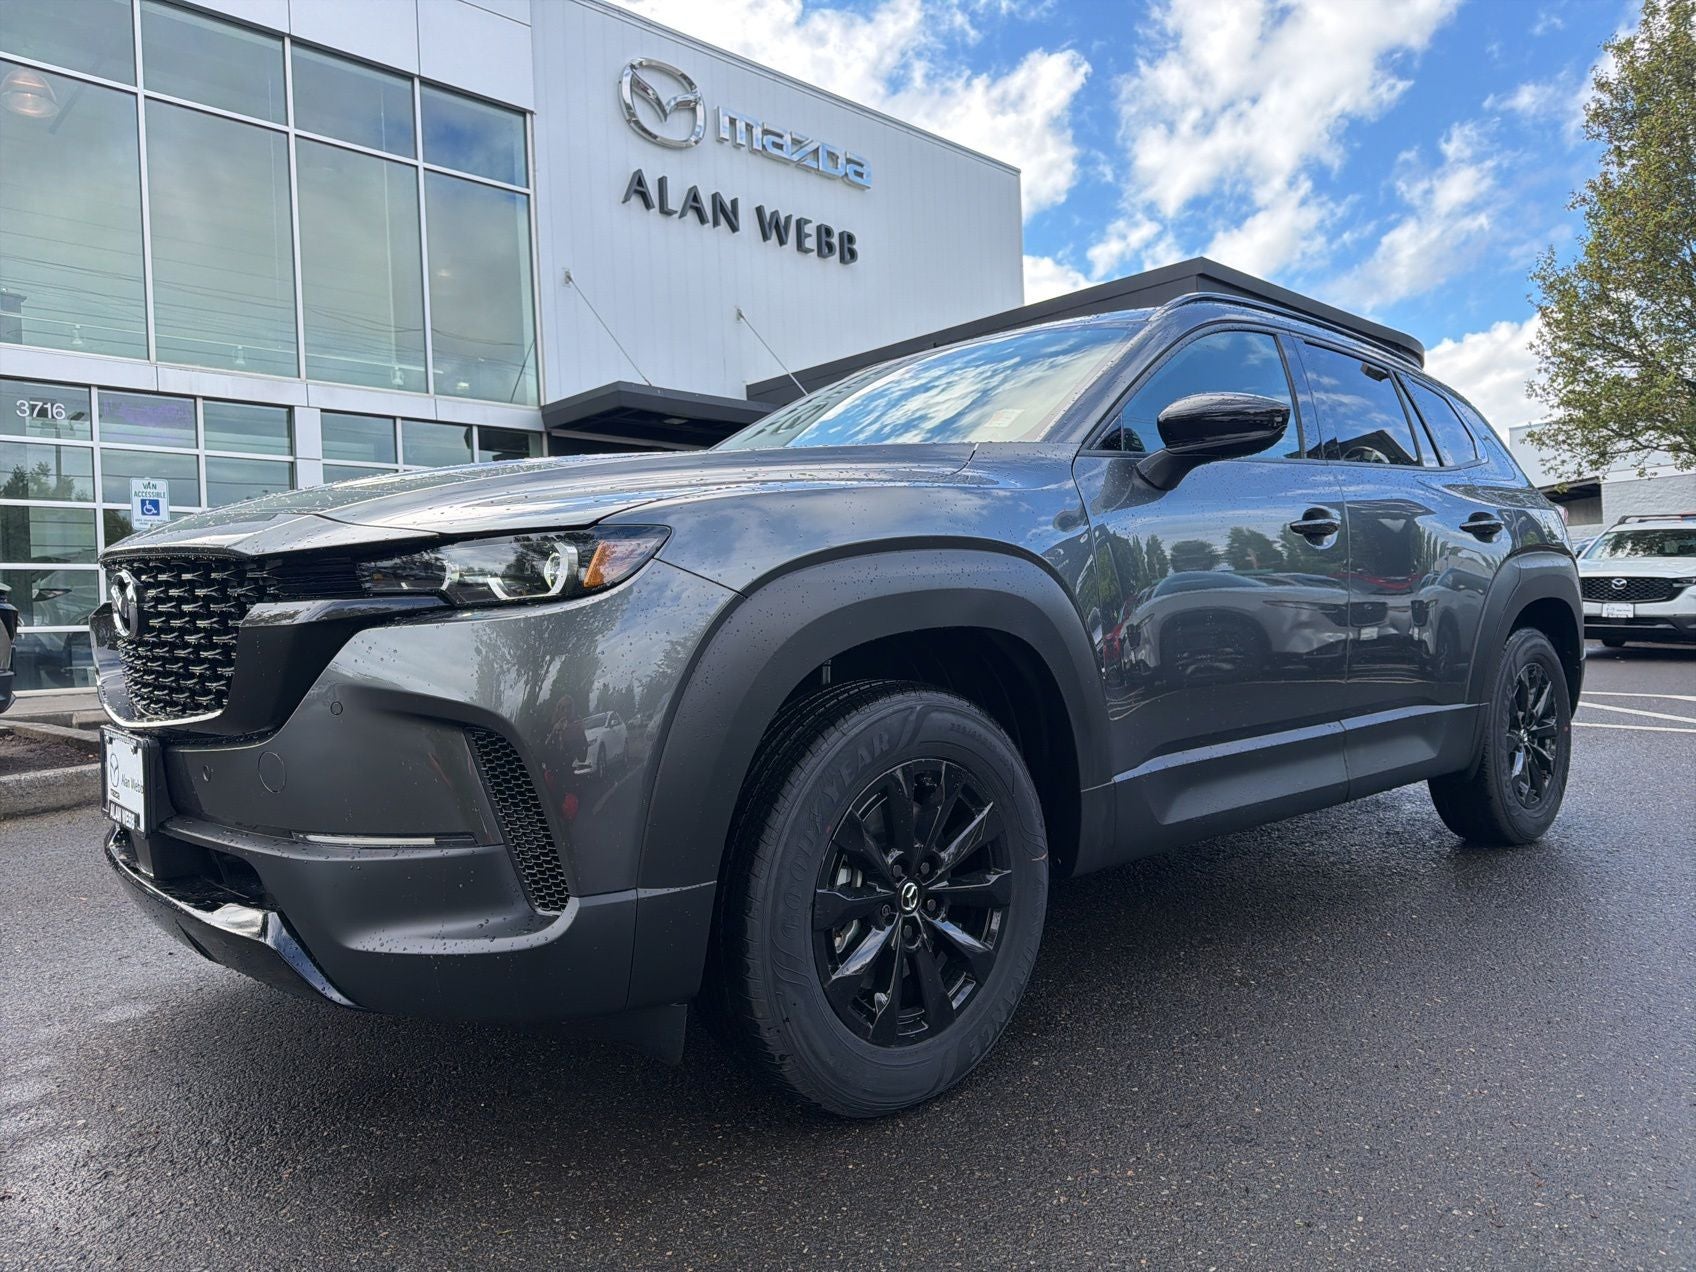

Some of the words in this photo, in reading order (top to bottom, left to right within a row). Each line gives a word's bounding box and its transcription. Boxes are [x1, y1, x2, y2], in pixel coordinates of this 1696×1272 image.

[621, 168, 740, 233] ALAN
[755, 204, 858, 264] WEBB
[16, 400, 66, 420] 3716
[143, 482, 157, 490] VAN
[134, 490, 166, 499] ACCESSIBLE
